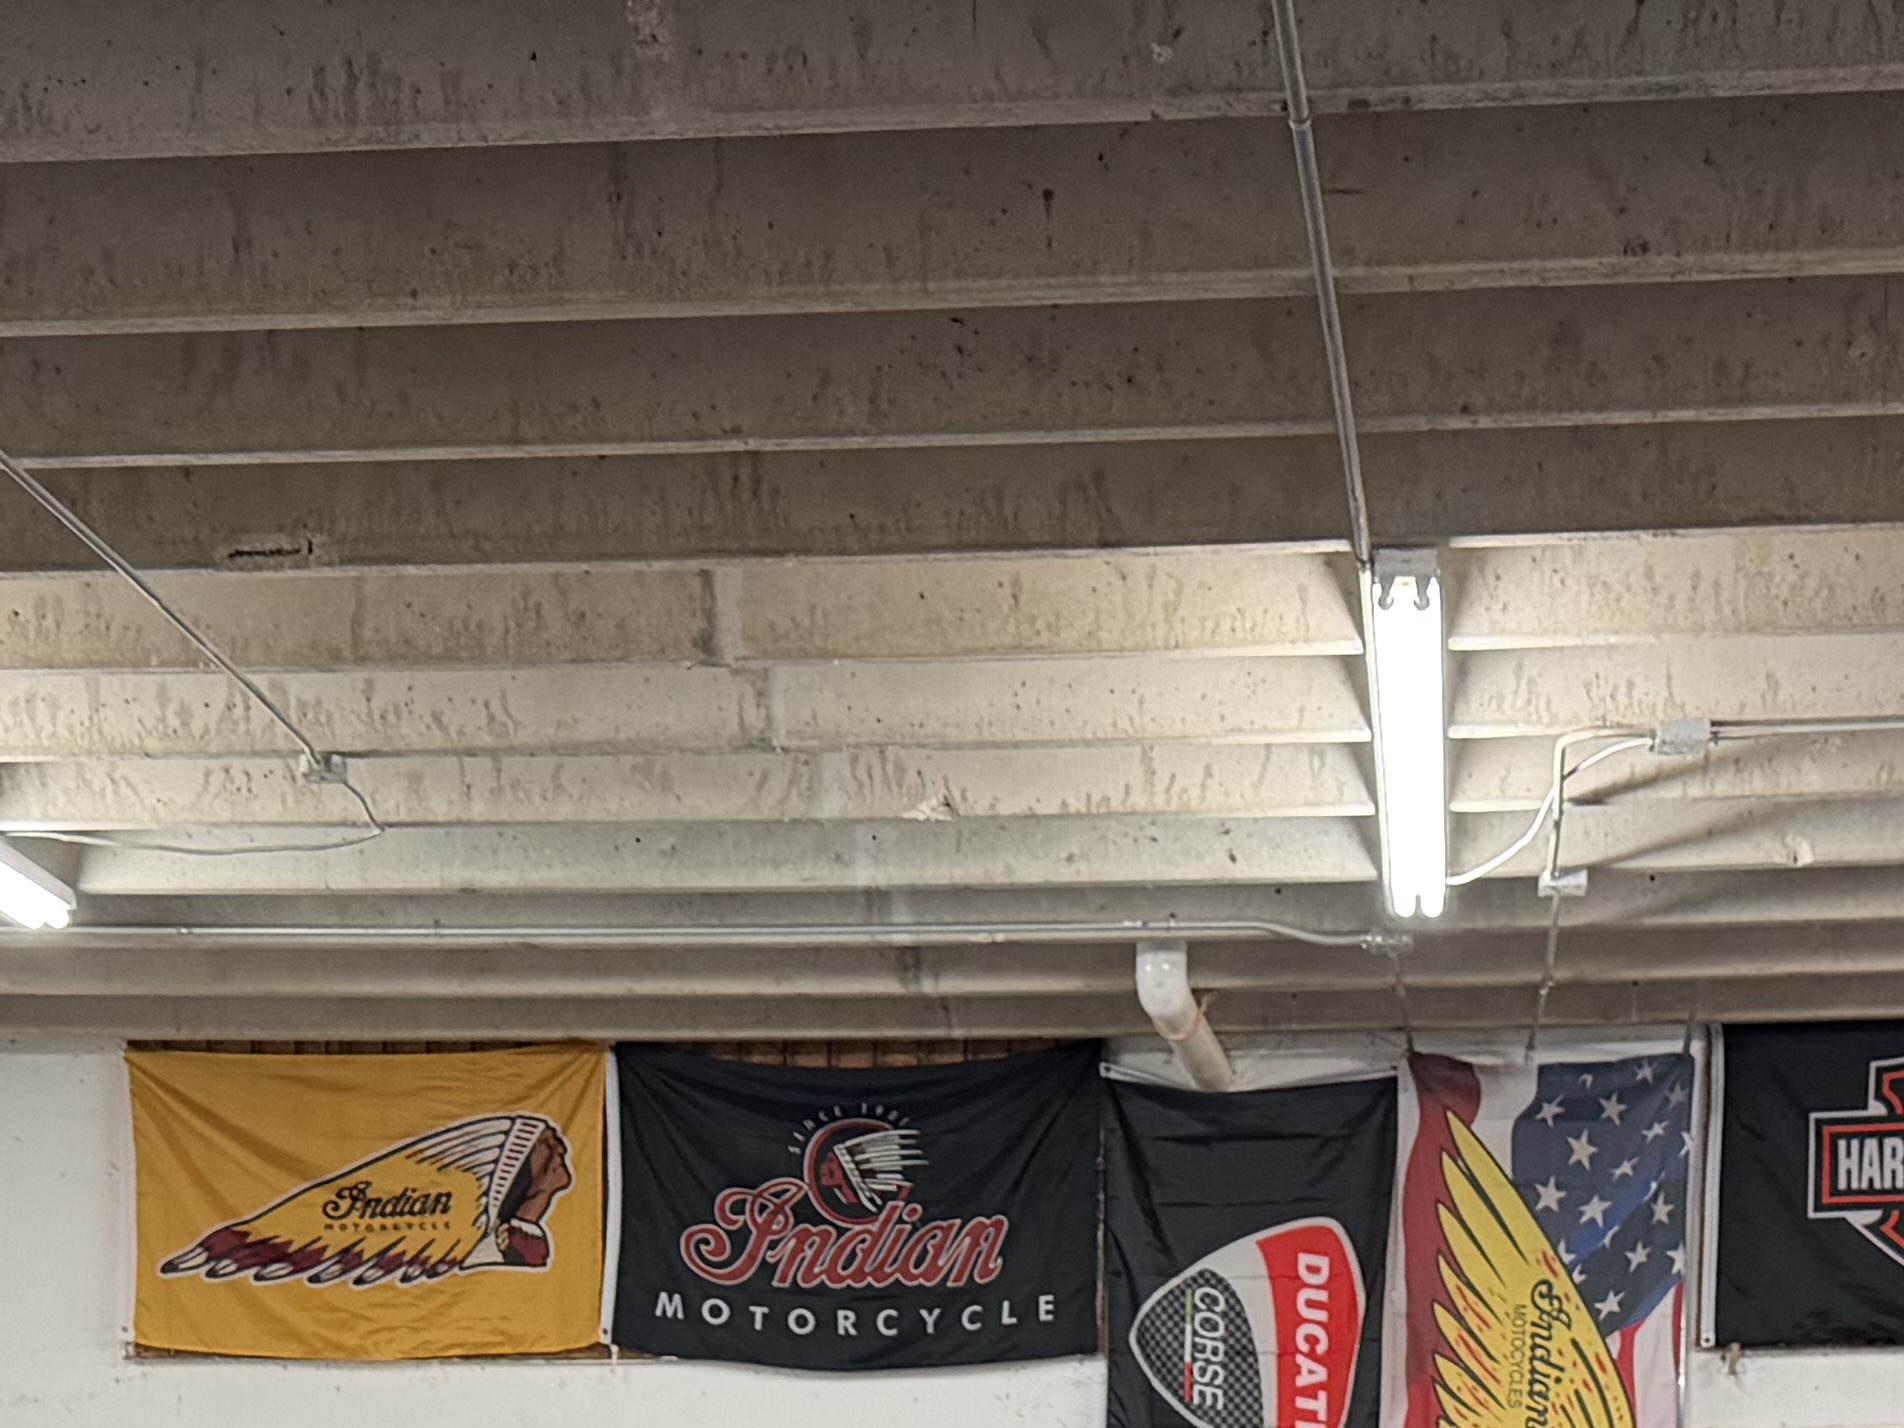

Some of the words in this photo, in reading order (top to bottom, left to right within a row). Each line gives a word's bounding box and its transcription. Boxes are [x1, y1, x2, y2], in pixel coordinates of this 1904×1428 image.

[322, 1180, 453, 1220] Indian
[324, 1221, 451, 1232] MOTORCYCLE
[680, 1177, 1010, 1289] Indian
[655, 1291, 1056, 1337] MOTORCYCLE
[1192, 1286, 1226, 1411] CORSE
